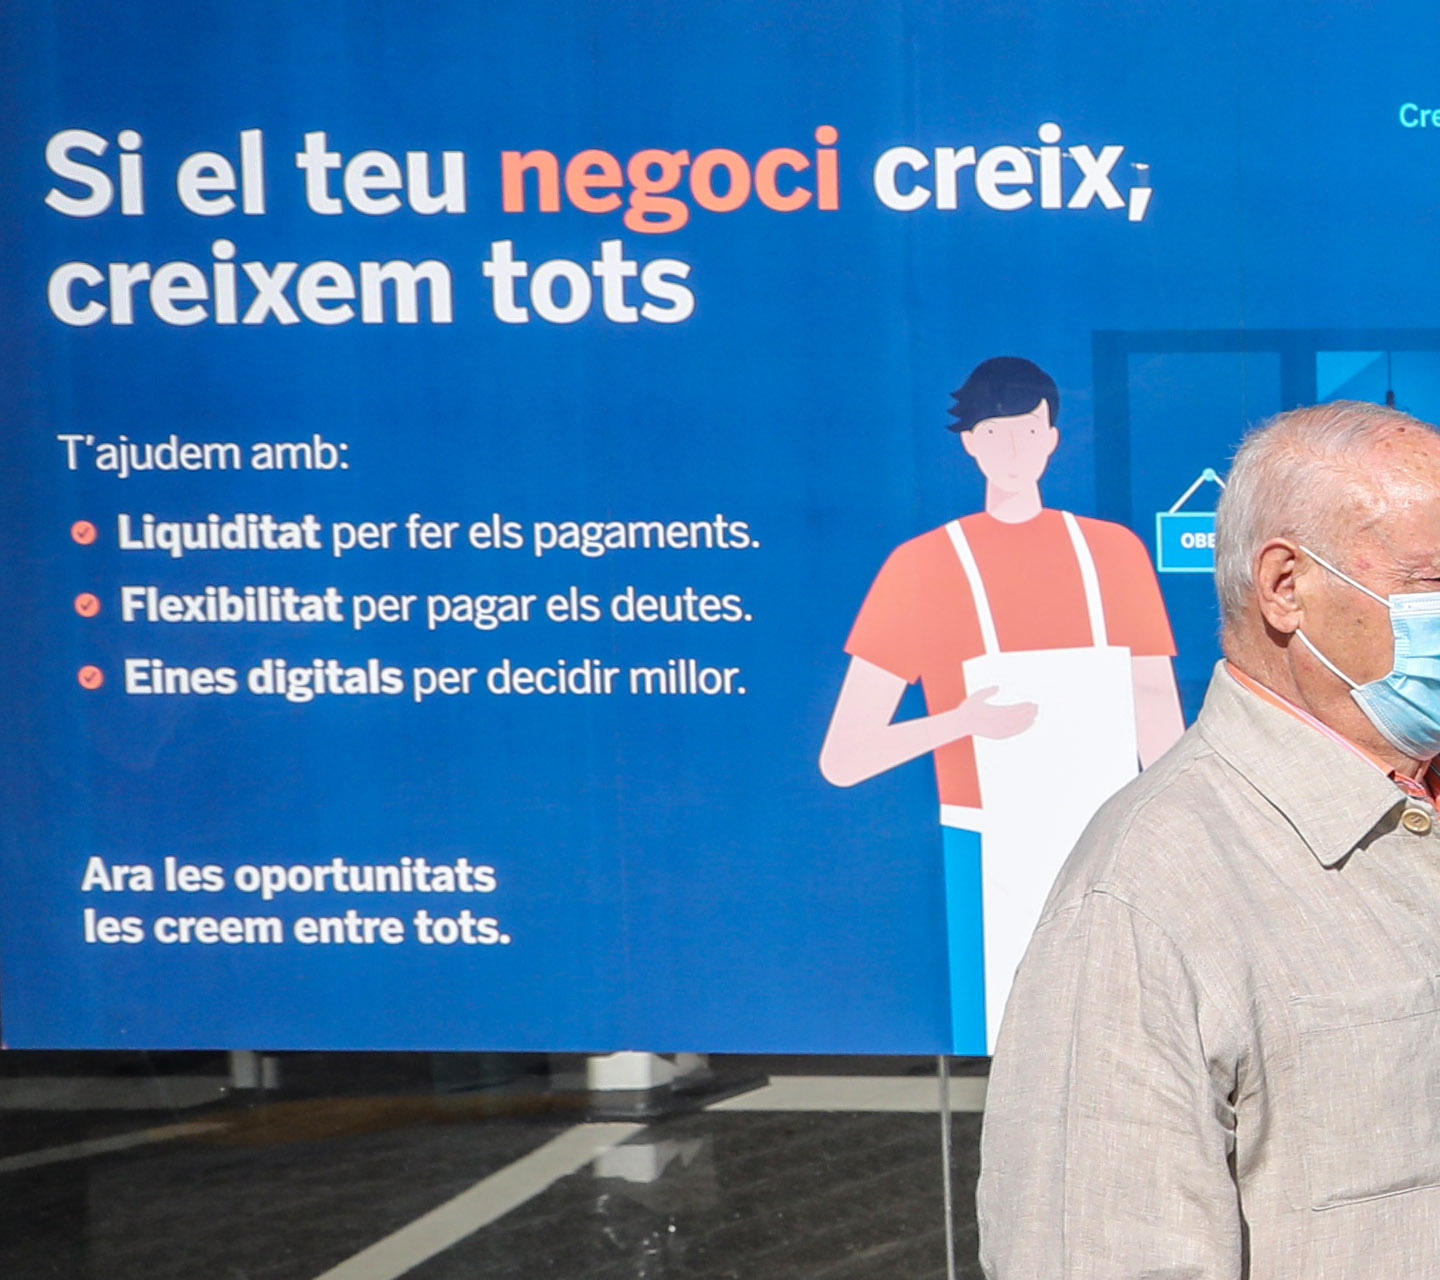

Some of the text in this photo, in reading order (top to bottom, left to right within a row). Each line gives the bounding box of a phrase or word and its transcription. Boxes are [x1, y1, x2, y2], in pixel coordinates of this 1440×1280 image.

[45, 122, 1153, 234] Si el teu negoci creix,
[47, 239, 695, 326] creixem tots
[57, 433, 349, 479] T'ajudem amb:
[117, 512, 760, 558] Liquiditat per fer els pagaments.
[121, 585, 753, 631] Flexibilitat per pagar els deutes.
[124, 658, 747, 703] Eines digitals per decidir millor.
[80, 855, 498, 901] Ara les oportunitats
[83, 907, 511, 945] les creem entre tots.
